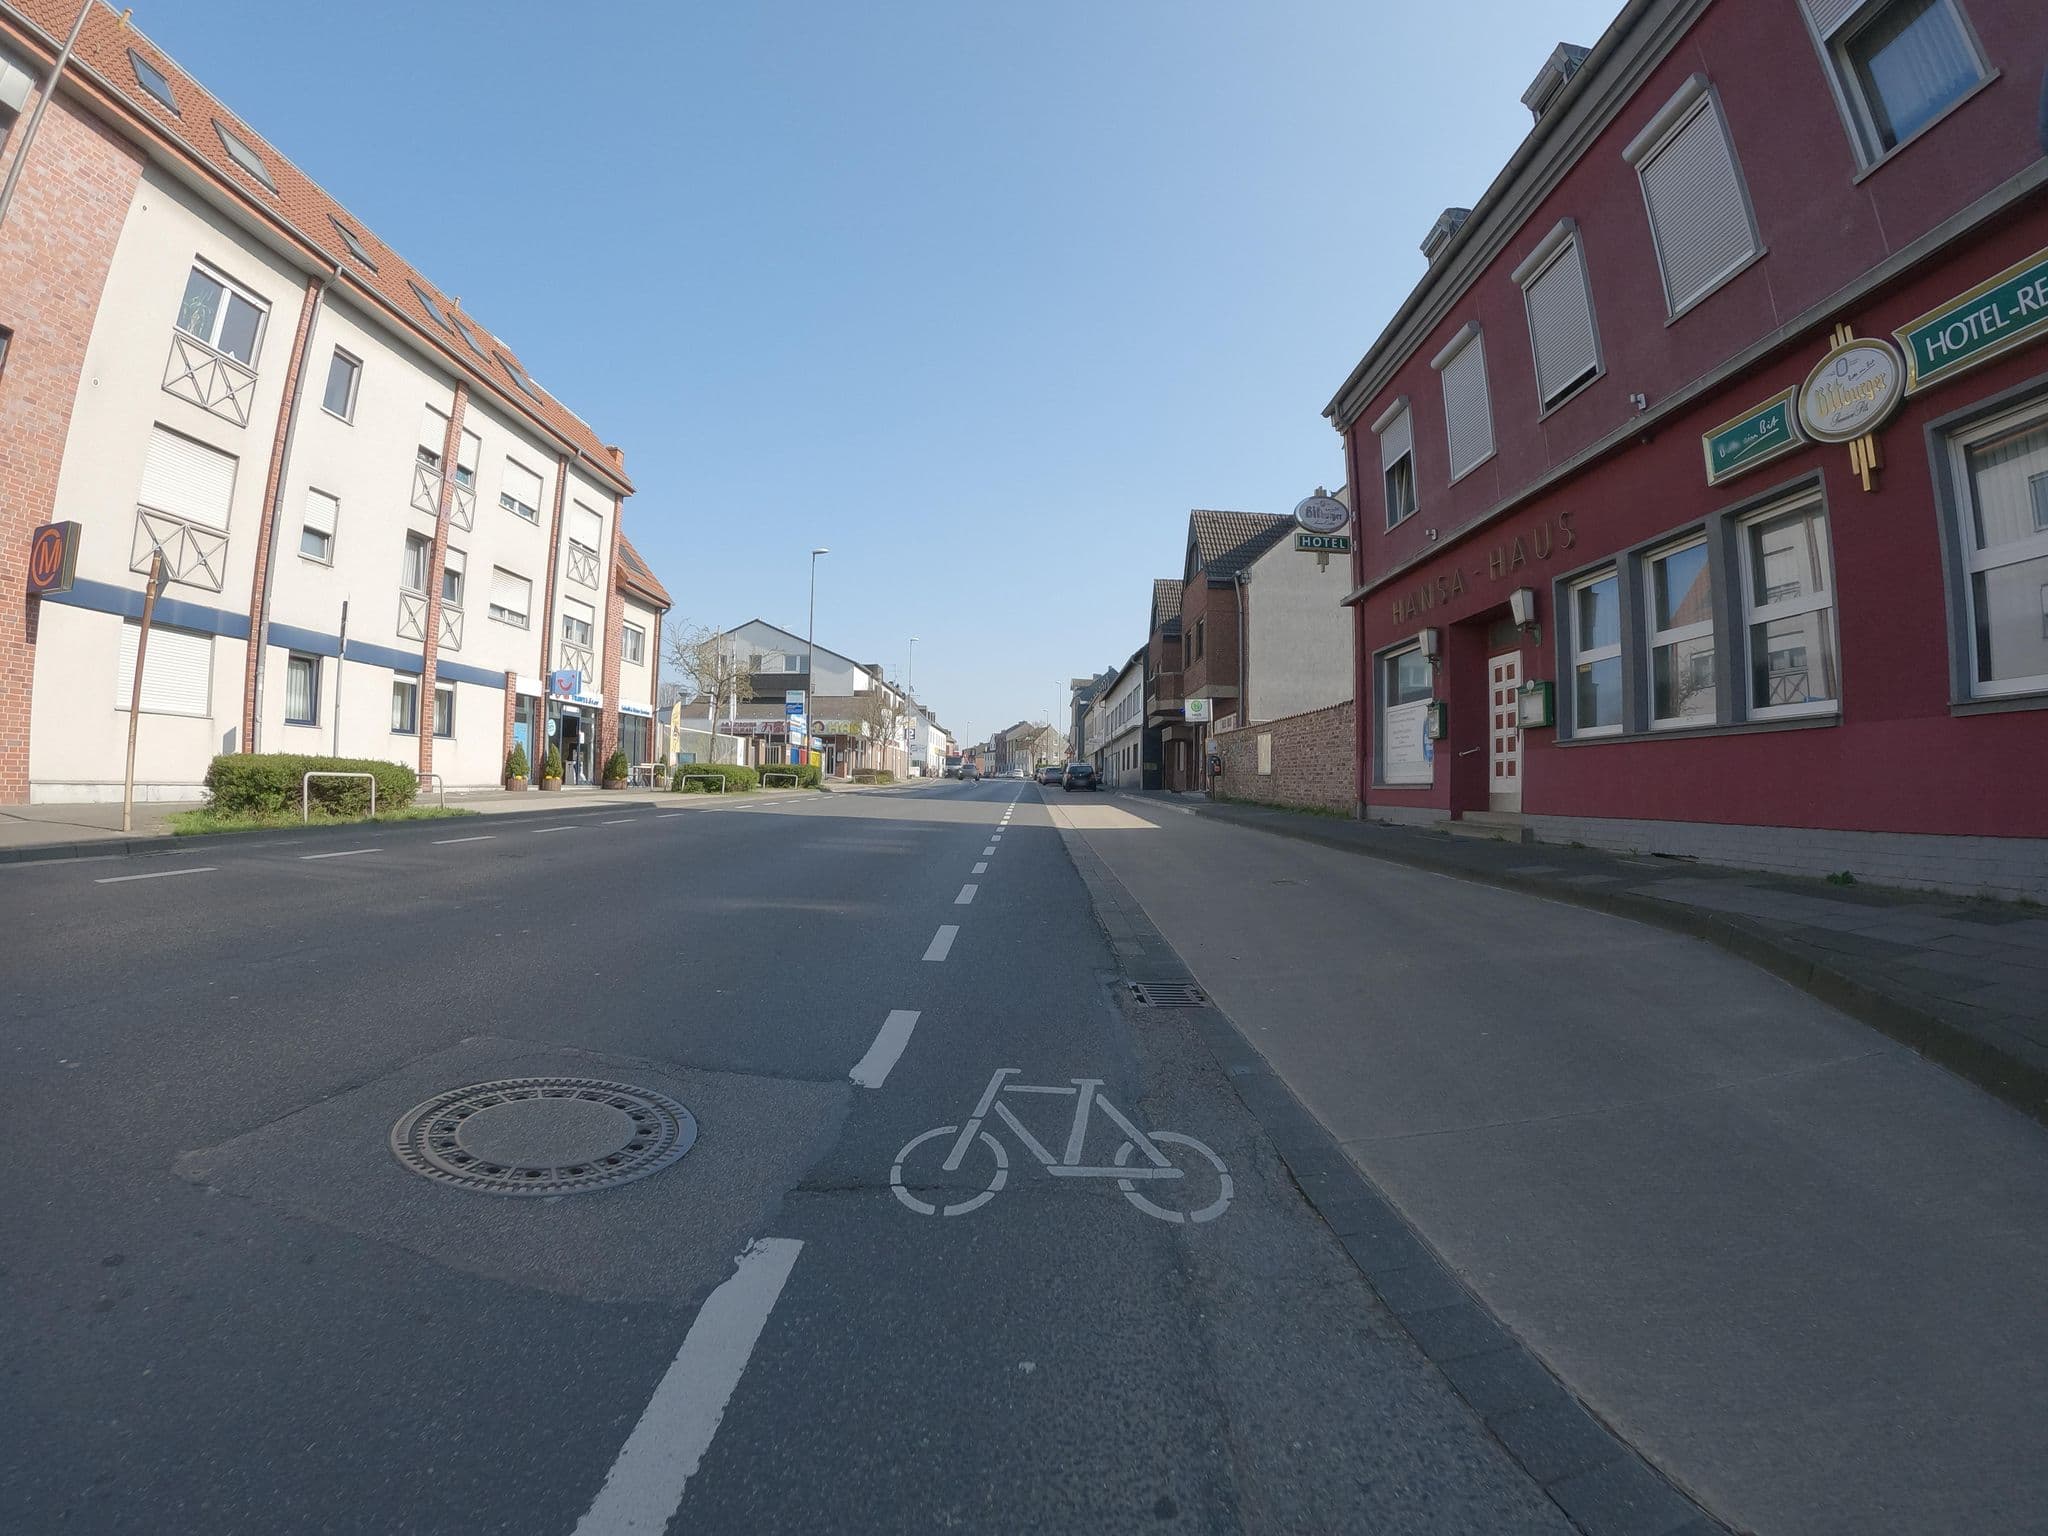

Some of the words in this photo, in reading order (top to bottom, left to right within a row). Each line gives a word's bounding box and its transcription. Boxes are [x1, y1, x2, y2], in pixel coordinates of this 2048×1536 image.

[1302, 536, 1346, 549] HOTEL
[1392, 568, 1465, 625] HANSA
[1488, 511, 1575, 581] HAUS
